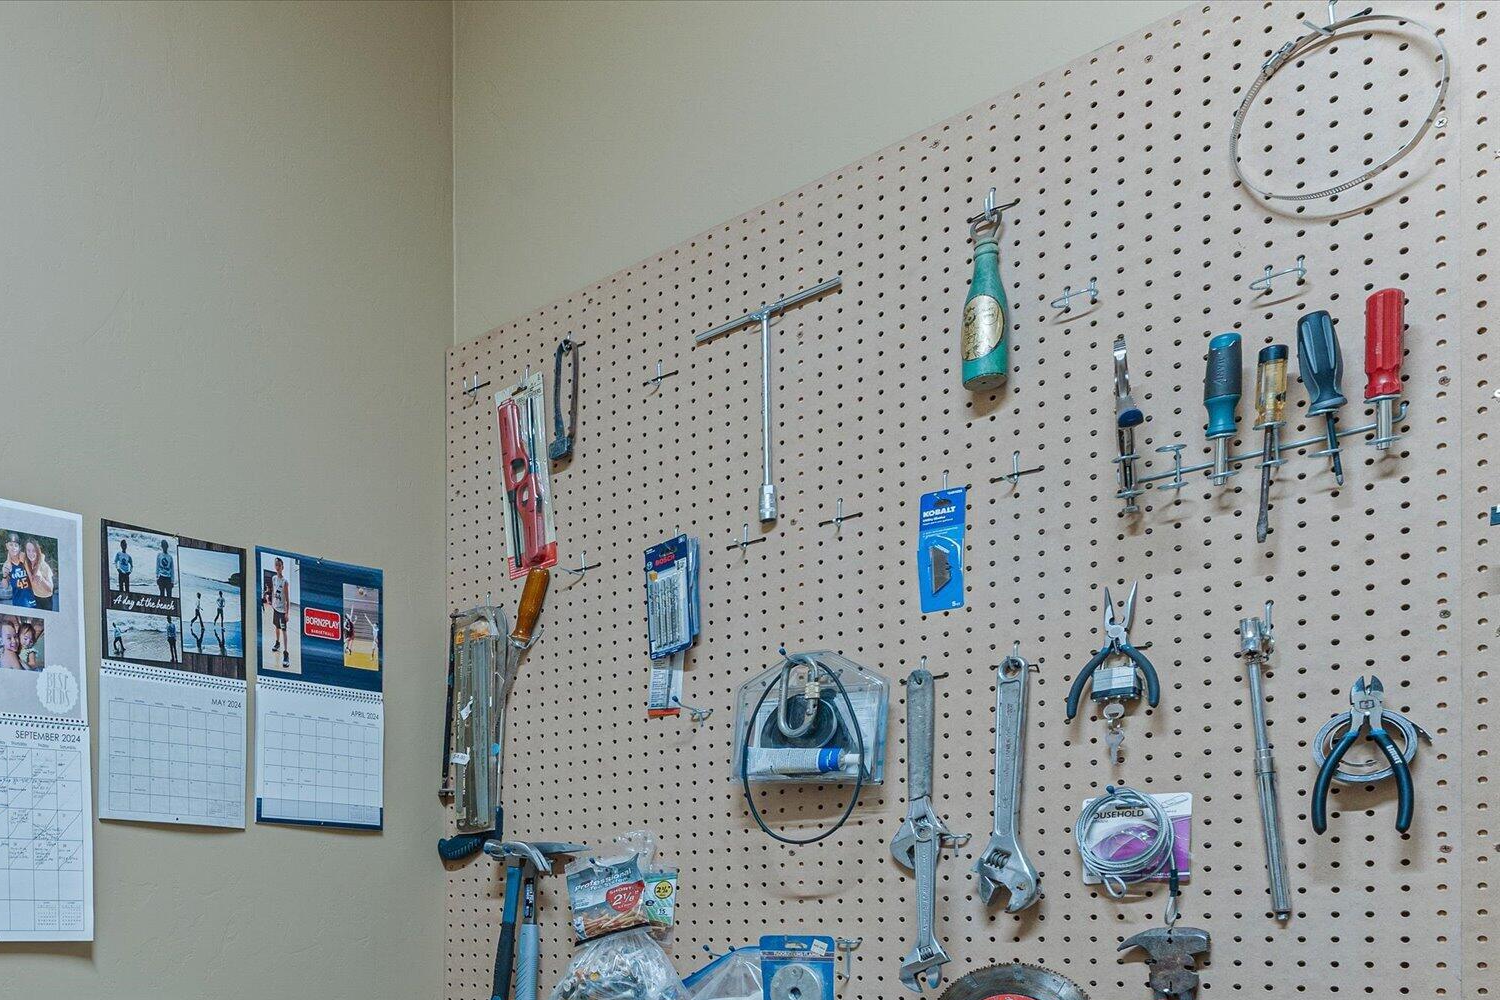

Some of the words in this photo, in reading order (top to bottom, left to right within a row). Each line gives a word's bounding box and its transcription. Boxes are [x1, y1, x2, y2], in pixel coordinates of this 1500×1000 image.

[922, 505, 956, 518] KOBALT
[654, 554, 676, 567] BOSCH
[16, 576, 29, 590] 45
[113, 595, 122, 604] A
[122, 596, 134, 610] day
[136, 597, 145, 607] at
[145, 597, 156, 608] the
[156, 599, 175, 611] beach
[305, 616, 340, 630] BORN2PLAY
[46, 672, 69, 686] BEST
[46, 687, 70, 705] BUDS
[228, 700, 242, 708] 2024
[350, 710, 366, 720] APRIL
[366, 712, 380, 720] 2024
[15, 730, 60, 742] SEPTEMBER
[62, 732, 81, 743] 2024
[1093, 810, 1144, 820] OUSEHOLD
[574, 868, 632, 892] Professional
